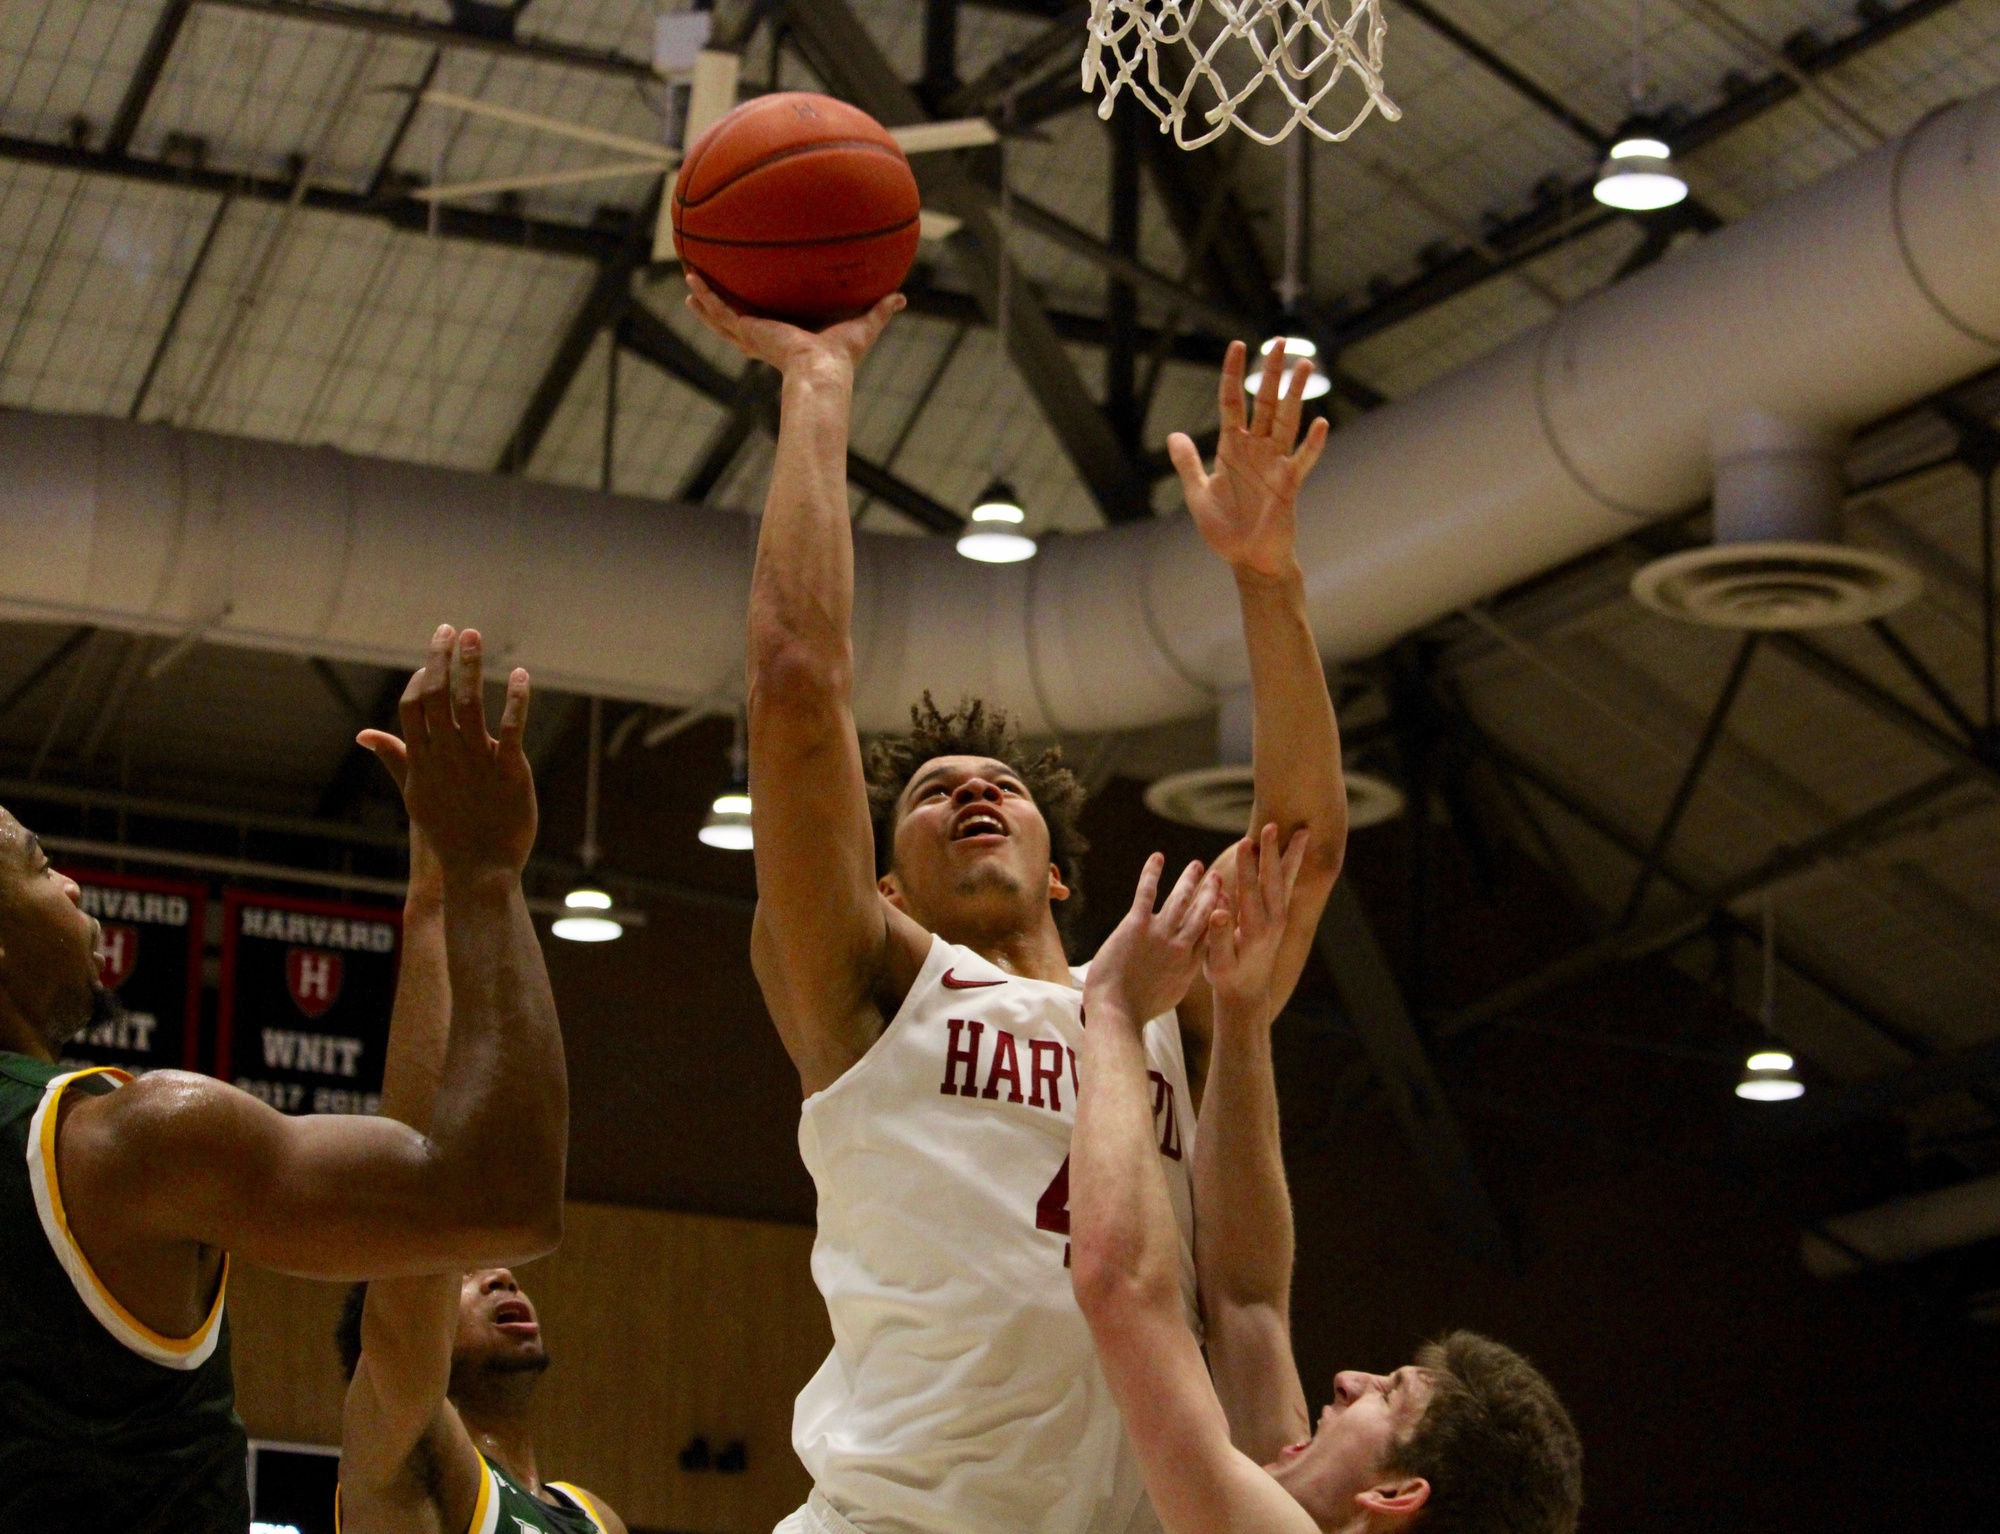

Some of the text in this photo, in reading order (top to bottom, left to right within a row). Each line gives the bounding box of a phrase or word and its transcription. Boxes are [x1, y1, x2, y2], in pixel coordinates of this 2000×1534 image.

[240, 906, 395, 954] HARVARD
[298, 953, 331, 1000] H
[261, 1027, 365, 1078] WNIT
[940, 1018, 1182, 1162] HARD
